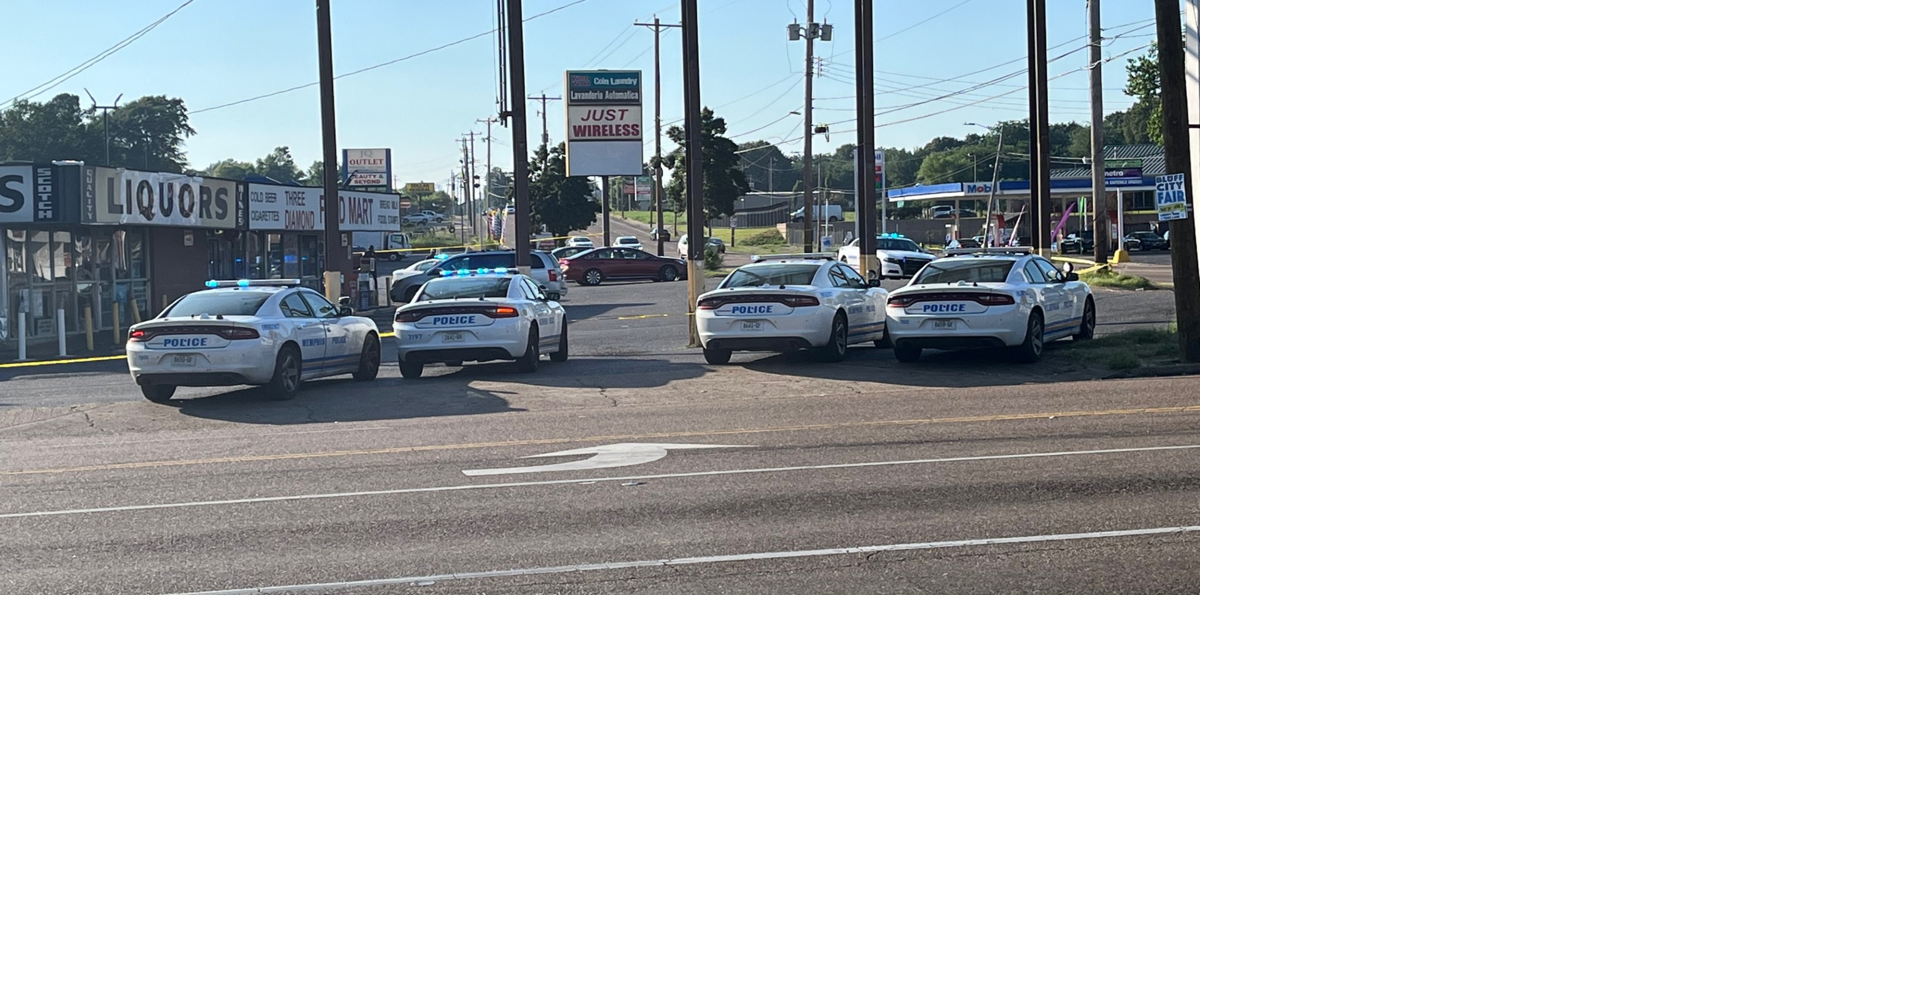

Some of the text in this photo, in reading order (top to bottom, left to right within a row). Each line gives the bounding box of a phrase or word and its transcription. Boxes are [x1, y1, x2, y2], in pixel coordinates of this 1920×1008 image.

[593, 77, 609, 86] Coin
[610, 77, 638, 86] Laundry
[570, 90, 639, 100] Lavanderia Automatica
[581, 109, 629, 122] JUST
[573, 124, 640, 138] WIRELESS
[349, 158, 384, 166] OUTLET
[1156, 174, 1183, 184] BLUFF
[1156, 181, 1184, 191] CITY
[37, 167, 53, 219] SCOTCH
[250, 191, 278, 203] COLD BEER
[1157, 190, 1185, 204] FAIR
[107, 177, 229, 221] LIQUORS
[284, 190, 306, 207] THREE
[319, 195, 374, 225] FD MART
[250, 210, 280, 222] CIGARETTES
[284, 209, 315, 230] DIAMOND
[731, 305, 773, 314] POLICE
[923, 303, 966, 313] POLICE
[432, 315, 476, 325] POLICE
[163, 337, 208, 347] POLICE
[302, 337, 325, 347] MEMPHIS
[408, 333, 423, 341] 7197
